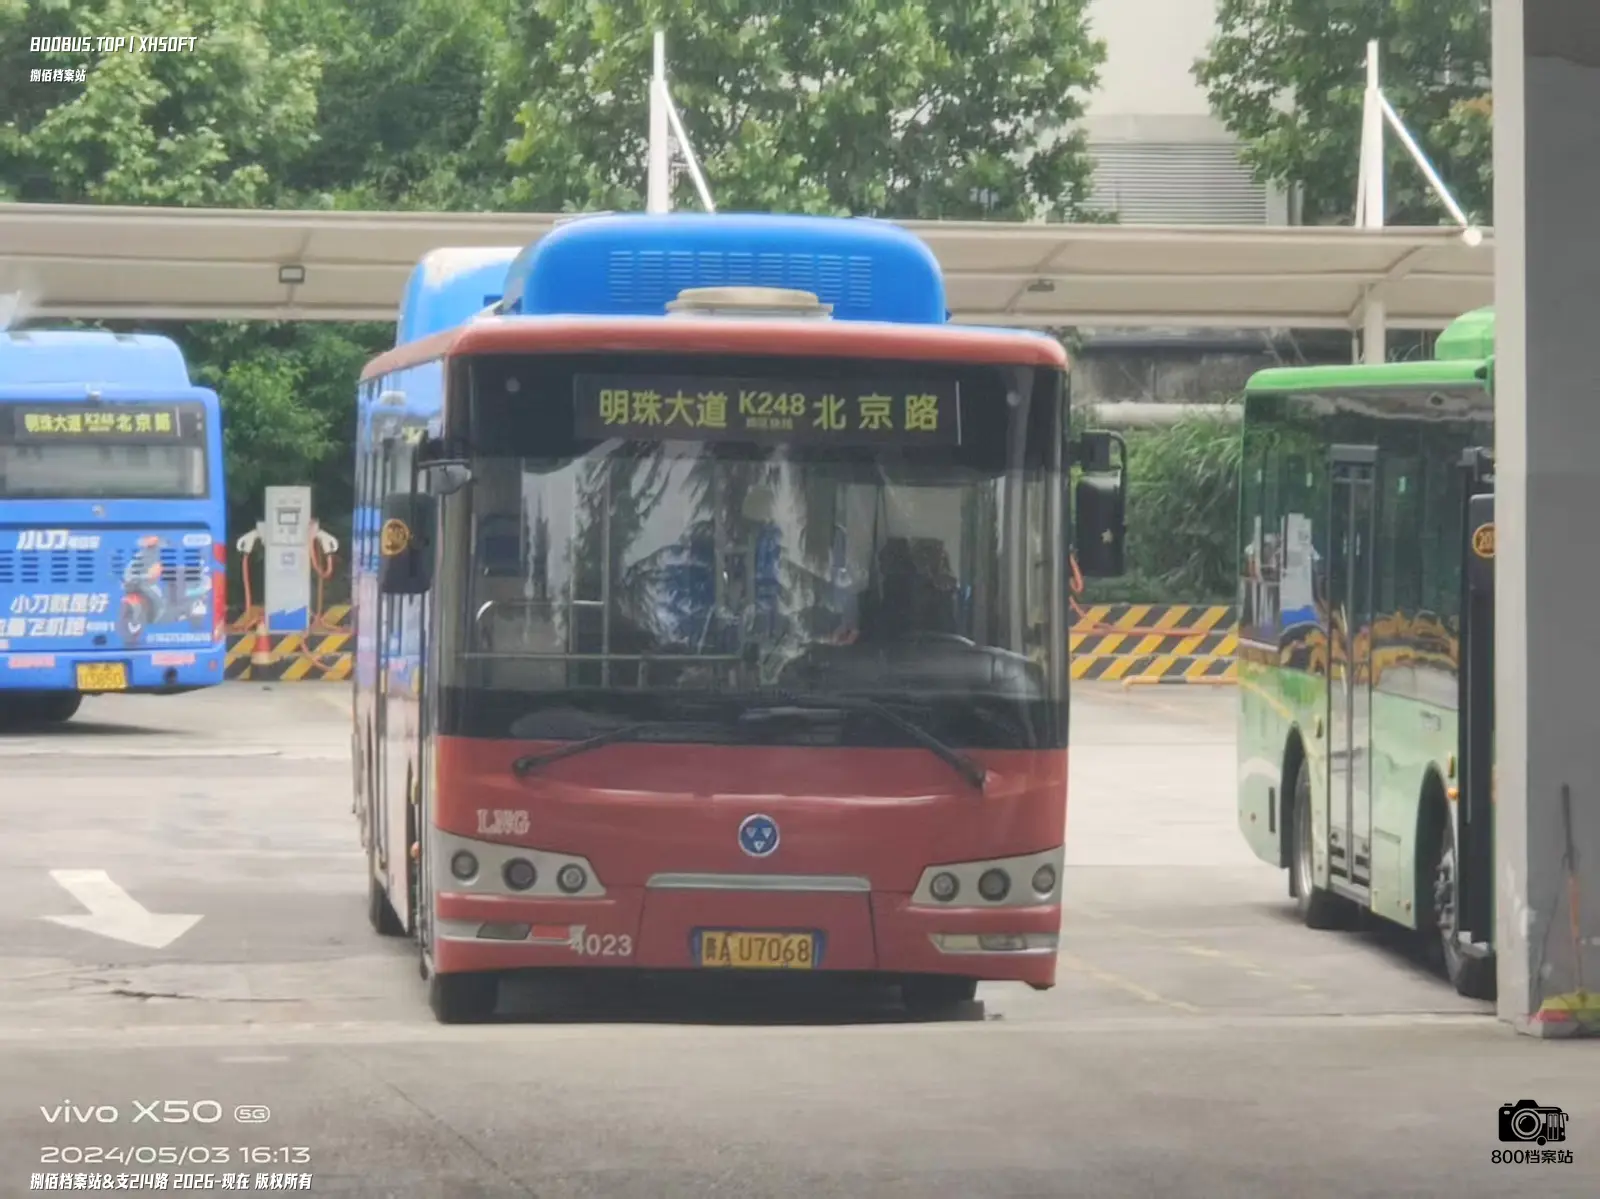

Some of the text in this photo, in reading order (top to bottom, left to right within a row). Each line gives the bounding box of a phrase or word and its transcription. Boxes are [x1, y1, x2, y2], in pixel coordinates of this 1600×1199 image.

[598, 389, 939, 432] 明珠大道 K248 北京路
[738, 936, 810, 963] U7068
